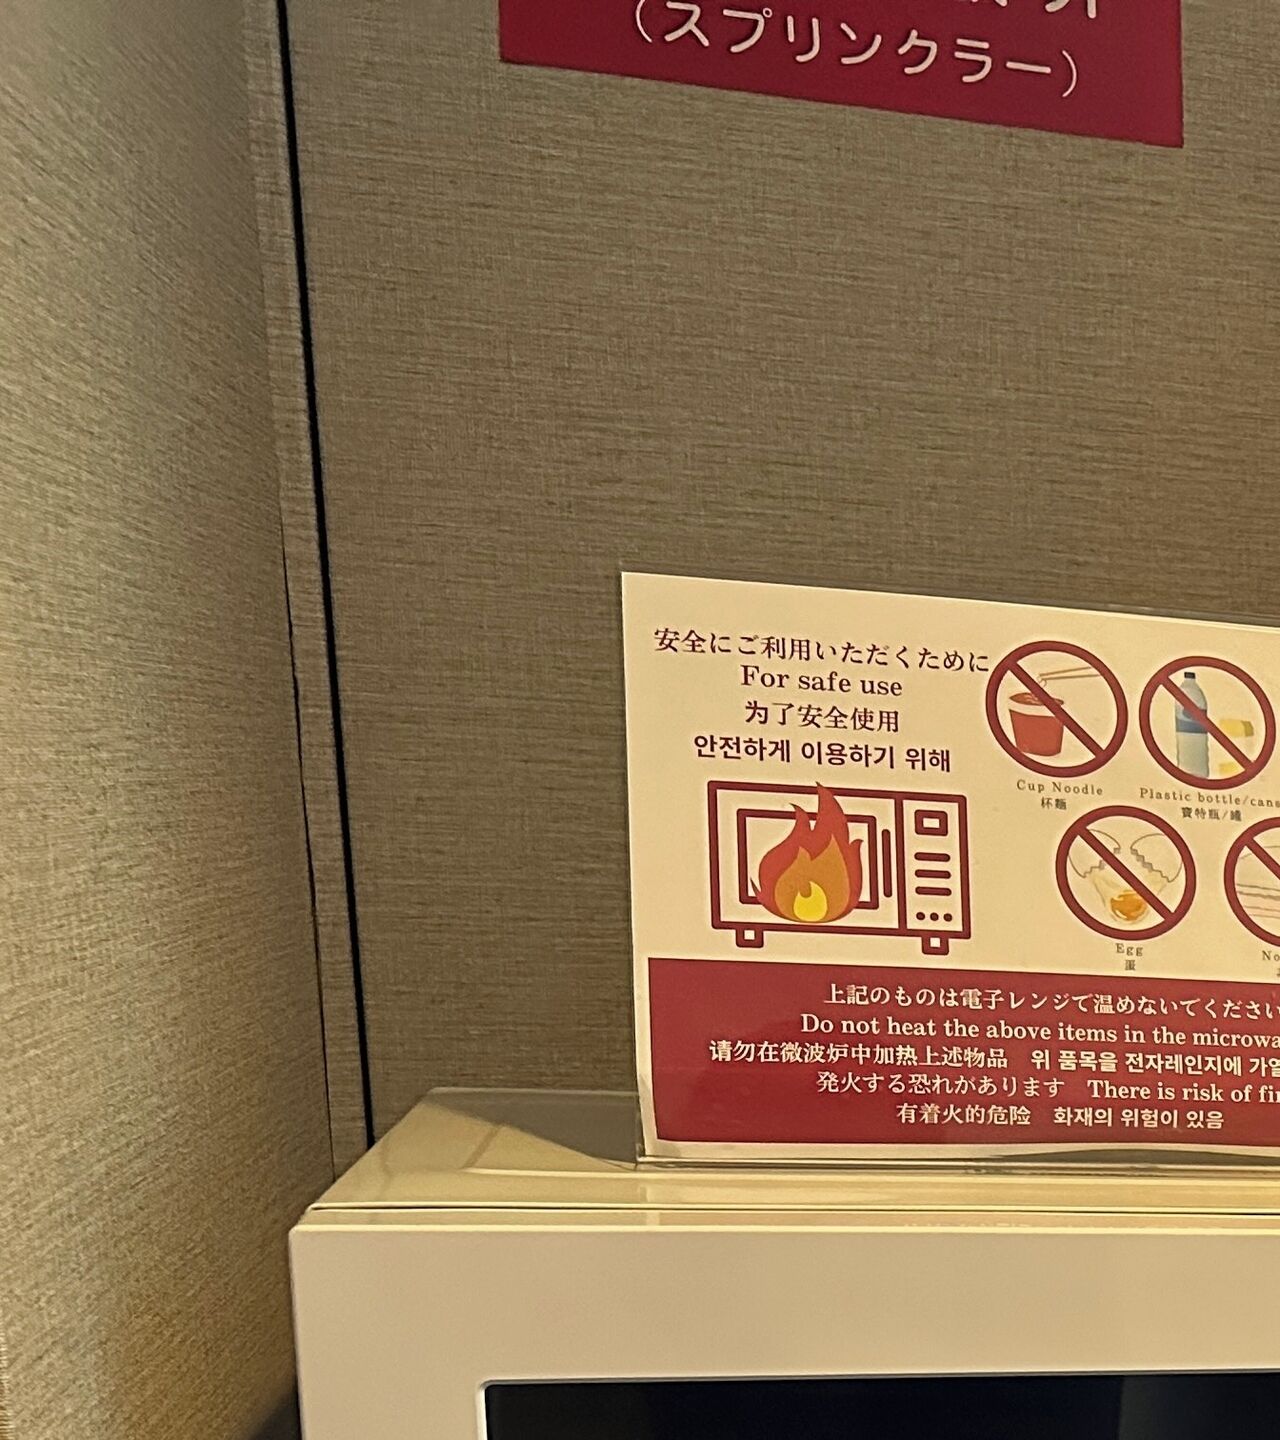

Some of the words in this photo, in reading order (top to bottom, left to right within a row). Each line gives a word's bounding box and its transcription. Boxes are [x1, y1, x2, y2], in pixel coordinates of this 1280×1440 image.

[654, 628, 989, 672] 安全にご利用いただくために
[740, 665, 790, 688] For
[799, 671, 851, 693] safe
[861, 679, 903, 696] use
[745, 701, 900, 733] 为了安全使用
[694, 735, 791, 763] 안전하게
[802, 742, 895, 769] 이용하기
[906, 748, 951, 773] 위해
[1017, 779, 1045, 794] Cup
[1051, 781, 1103, 796] Noodle
[1140, 787, 1190, 803] Plastic
[1198, 790, 1280, 808] bottle/cans
[1116, 943, 1143, 958] Egg
[800, 1013, 834, 1034] Do
[841, 1016, 880, 1036] not
[887, 1016, 936, 1037] heat
[943, 1018, 980, 1038] the
[986, 1020, 1051, 1040] above
[1058, 1025, 1118, 1044] items
[1124, 1025, 1145, 1044] in
[1152, 1026, 1186, 1046] the
[709, 1040, 1008, 1068] 请勿在微波炉中加热上述物品
[1031, 1049, 1050, 1070] 위
[1058, 1050, 1118, 1072] 품목을
[1126, 1053, 1241, 1077] 전자레인지에
[816, 1071, 1065, 1098] 発火する恐れがあります
[1088, 1080, 1151, 1099] There
[1158, 1081, 1175, 1100] is
[1182, 1082, 1224, 1102] risk
[1230, 1084, 1252, 1103] of
[896, 1103, 1032, 1125] 有着火的危险
[1053, 1106, 1113, 1127] 화재의
[1120, 1107, 1178, 1128] 위험이
[1186, 1110, 1224, 1130] 있음
